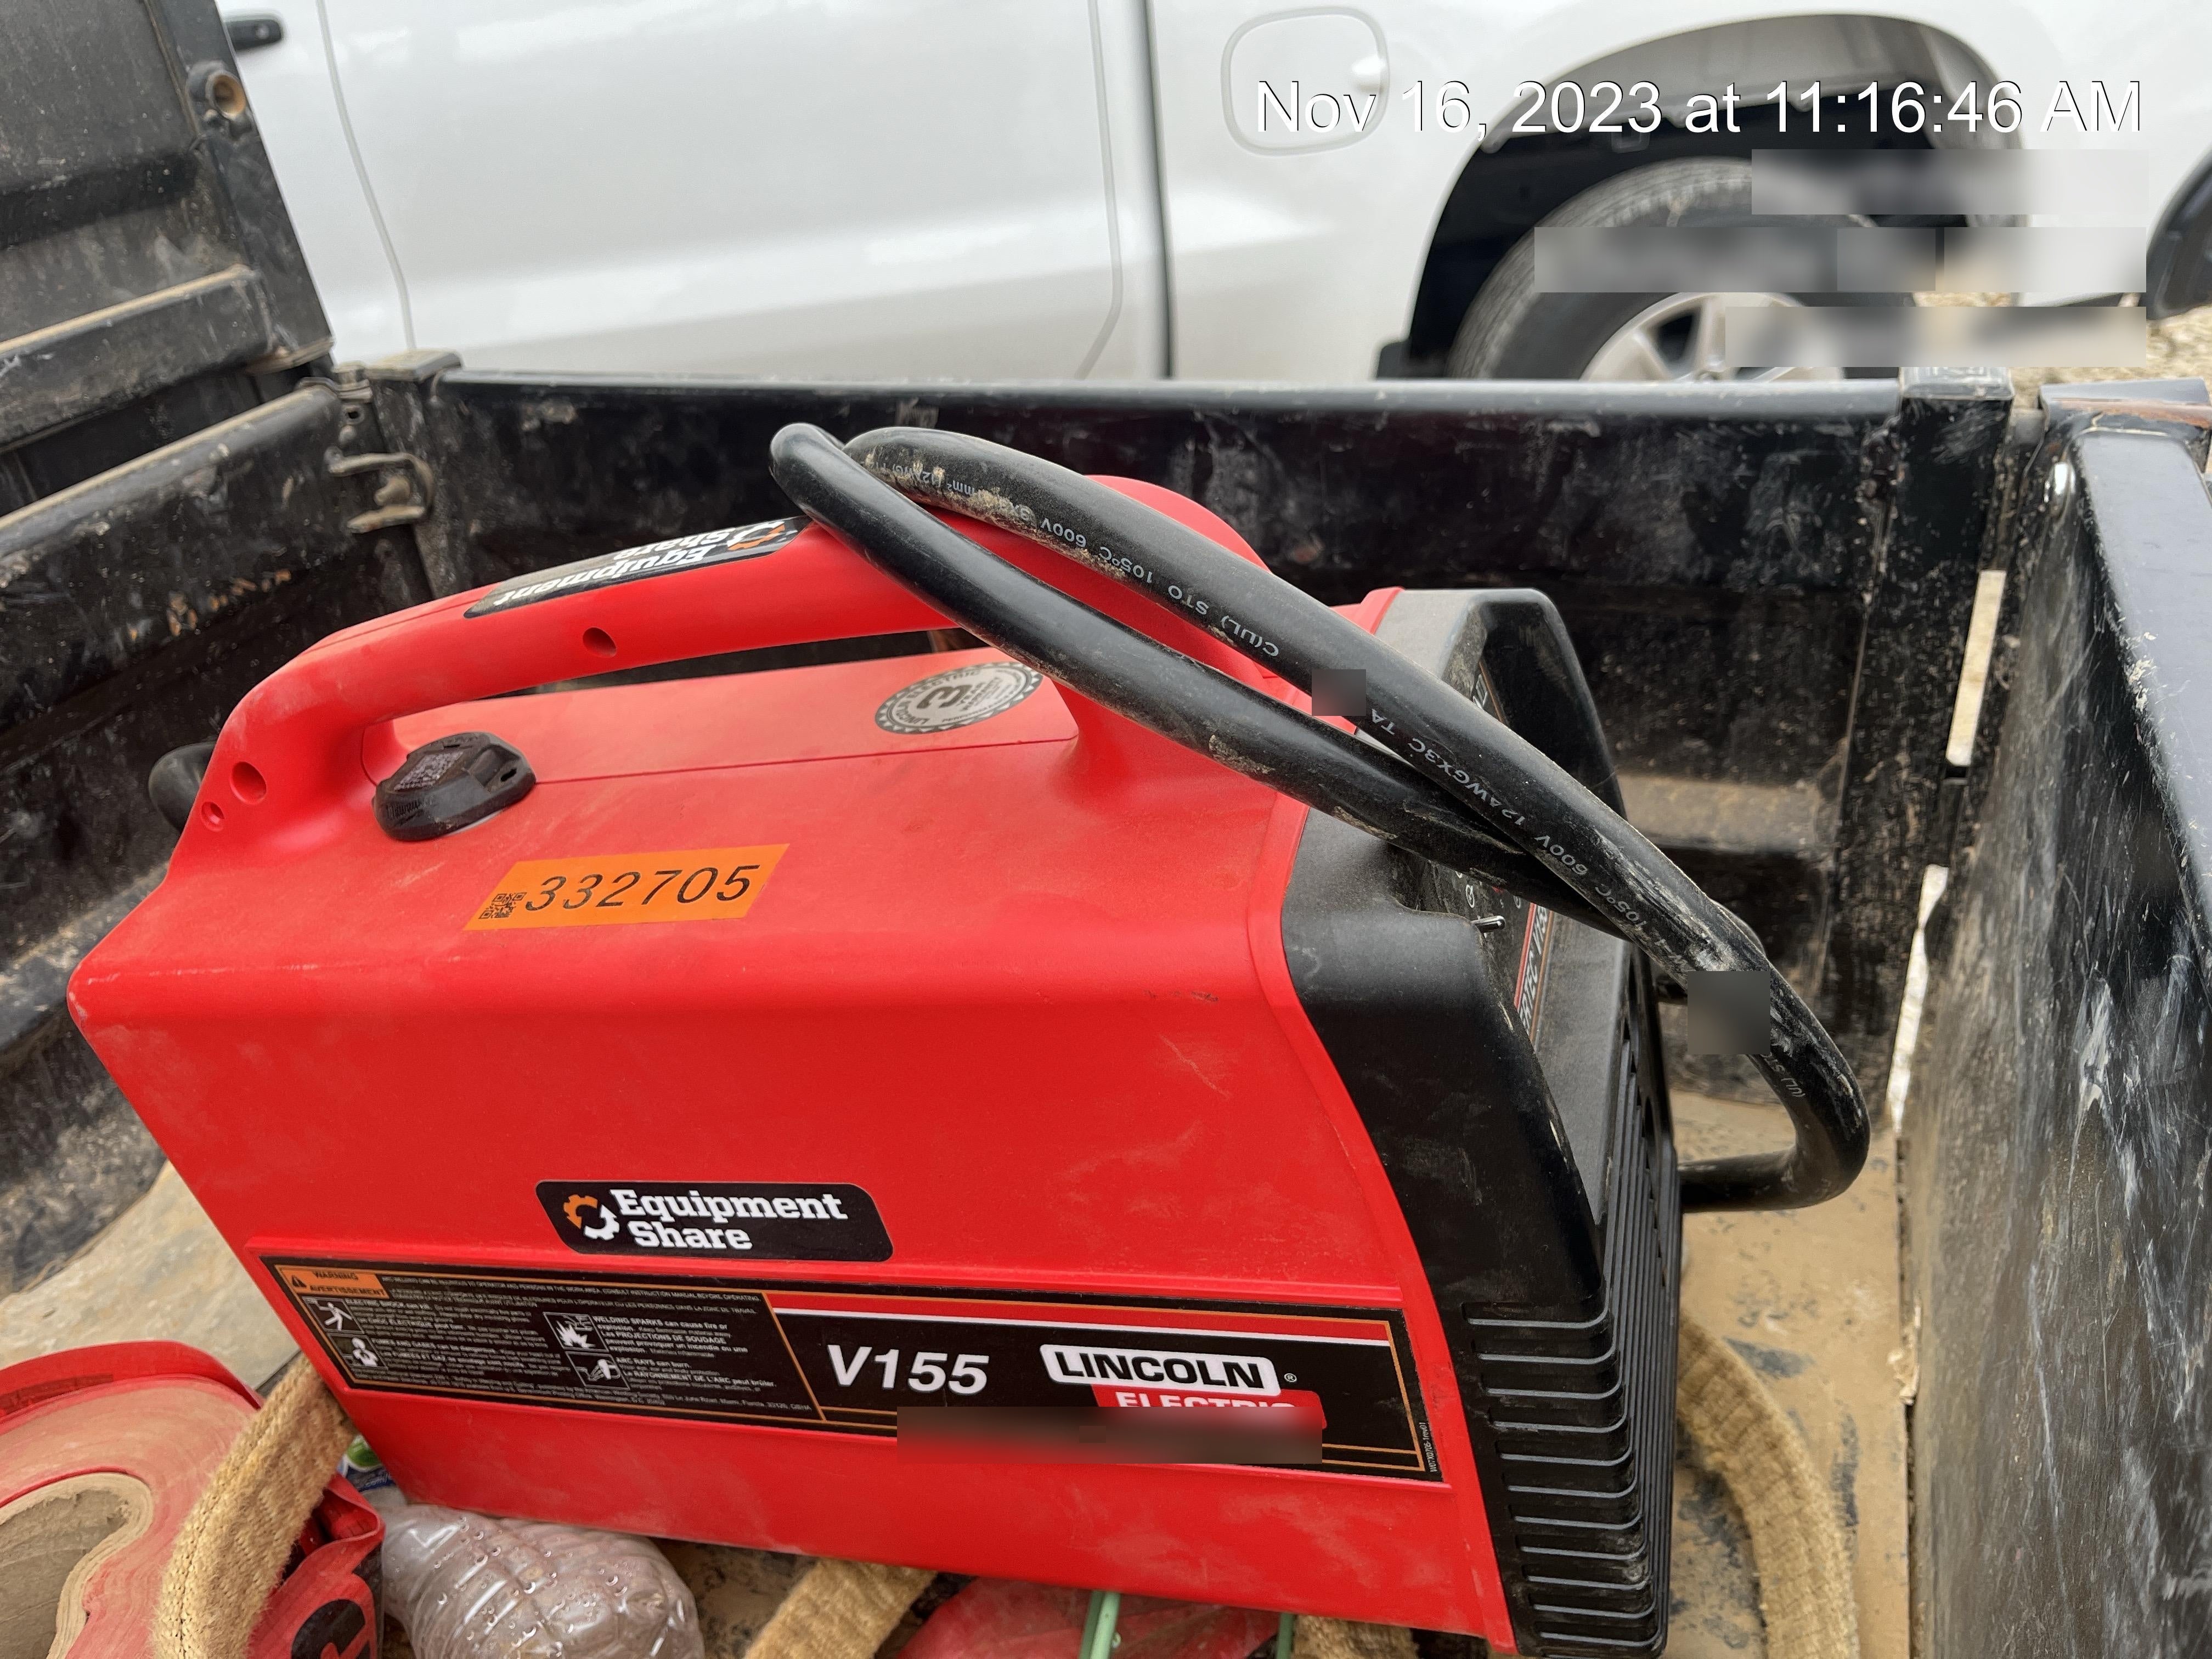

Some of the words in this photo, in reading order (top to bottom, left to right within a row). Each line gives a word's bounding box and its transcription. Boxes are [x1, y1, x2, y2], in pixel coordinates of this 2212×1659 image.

[613, 528, 736, 560] Share
[1040, 518, 1088, 549] 600V
[494, 544, 717, 606] Equipment
[1534, 834, 1588, 876] 600V
[525, 865, 760, 911] 332705
[609, 1189, 848, 1223] Equipment
[627, 1221, 752, 1250] Share
[827, 1344, 989, 1395] V155
[1054, 1350, 1265, 1389] LINCOLN
